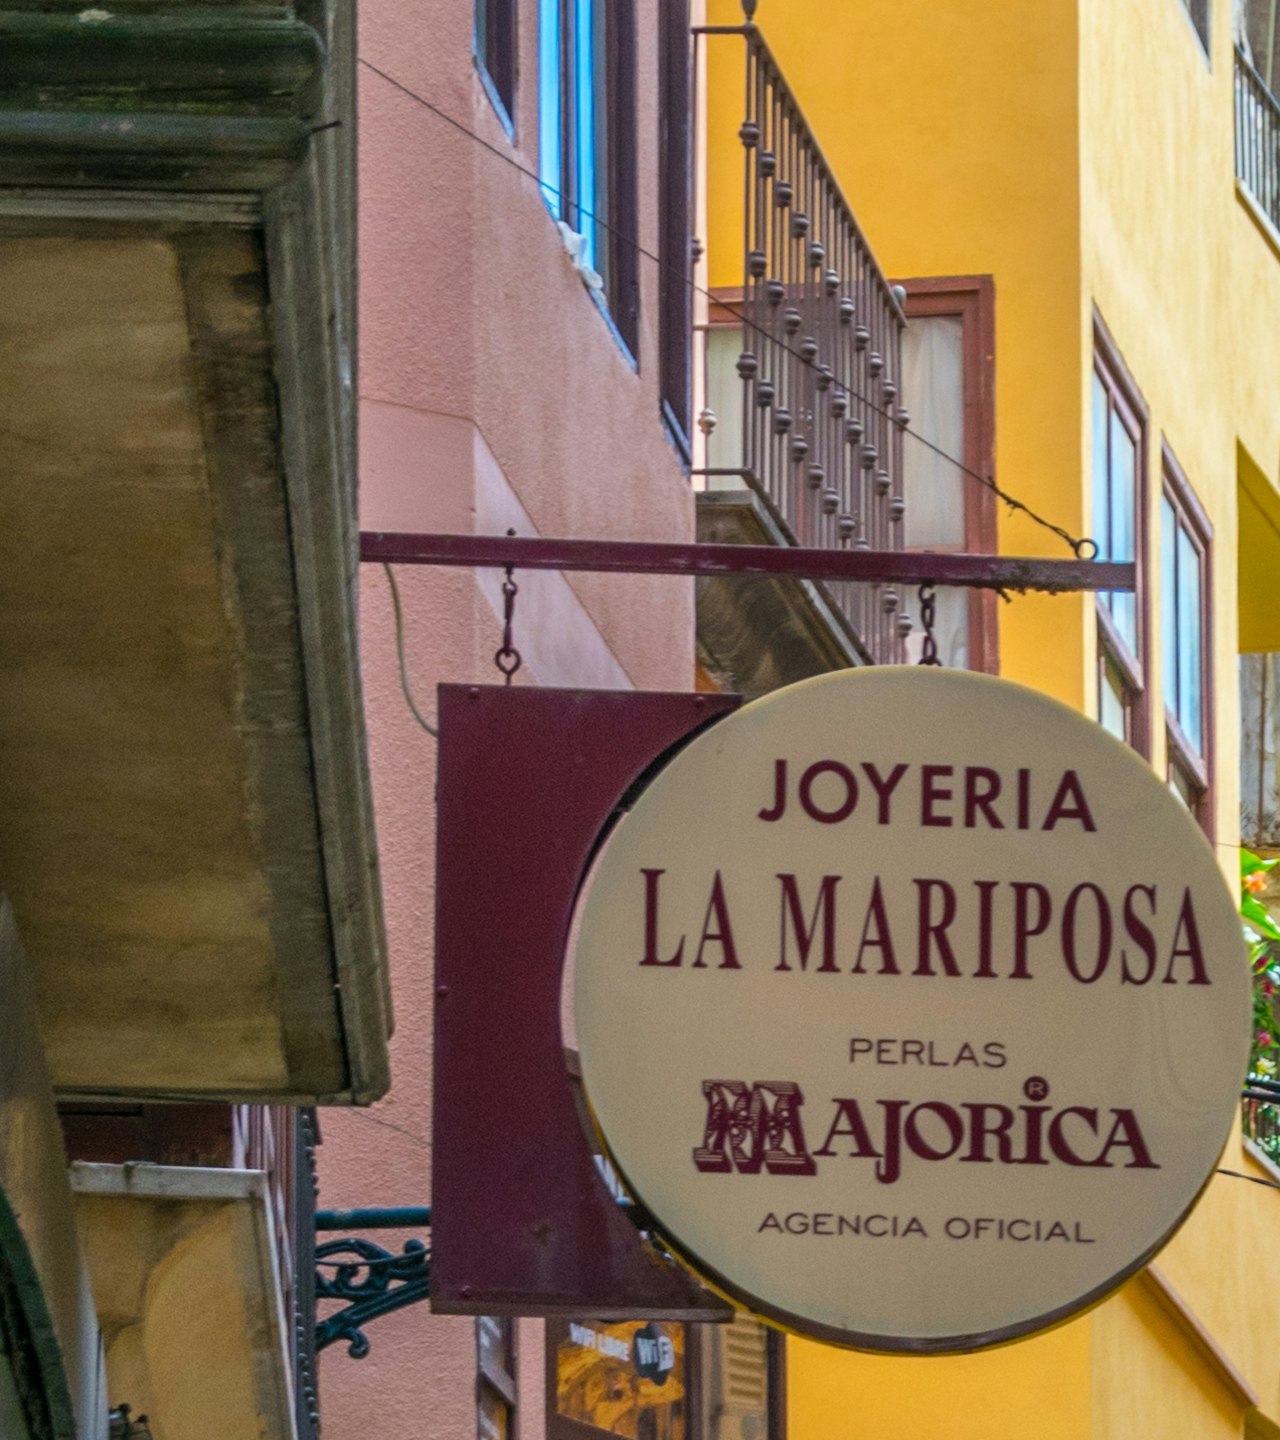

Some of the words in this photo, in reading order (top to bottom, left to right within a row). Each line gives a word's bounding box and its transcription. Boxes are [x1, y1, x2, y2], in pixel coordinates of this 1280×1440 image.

[757, 758, 1097, 833] JOYERIA
[639, 867, 741, 969] LA
[775, 872, 1212, 986] MARIPOSA
[848, 1038, 1007, 1069] PERLAS
[692, 1075, 1161, 1185] MAJORICA
[757, 1211, 927, 1238] AGENCIA
[945, 1216, 1096, 1244] OFICIAL
